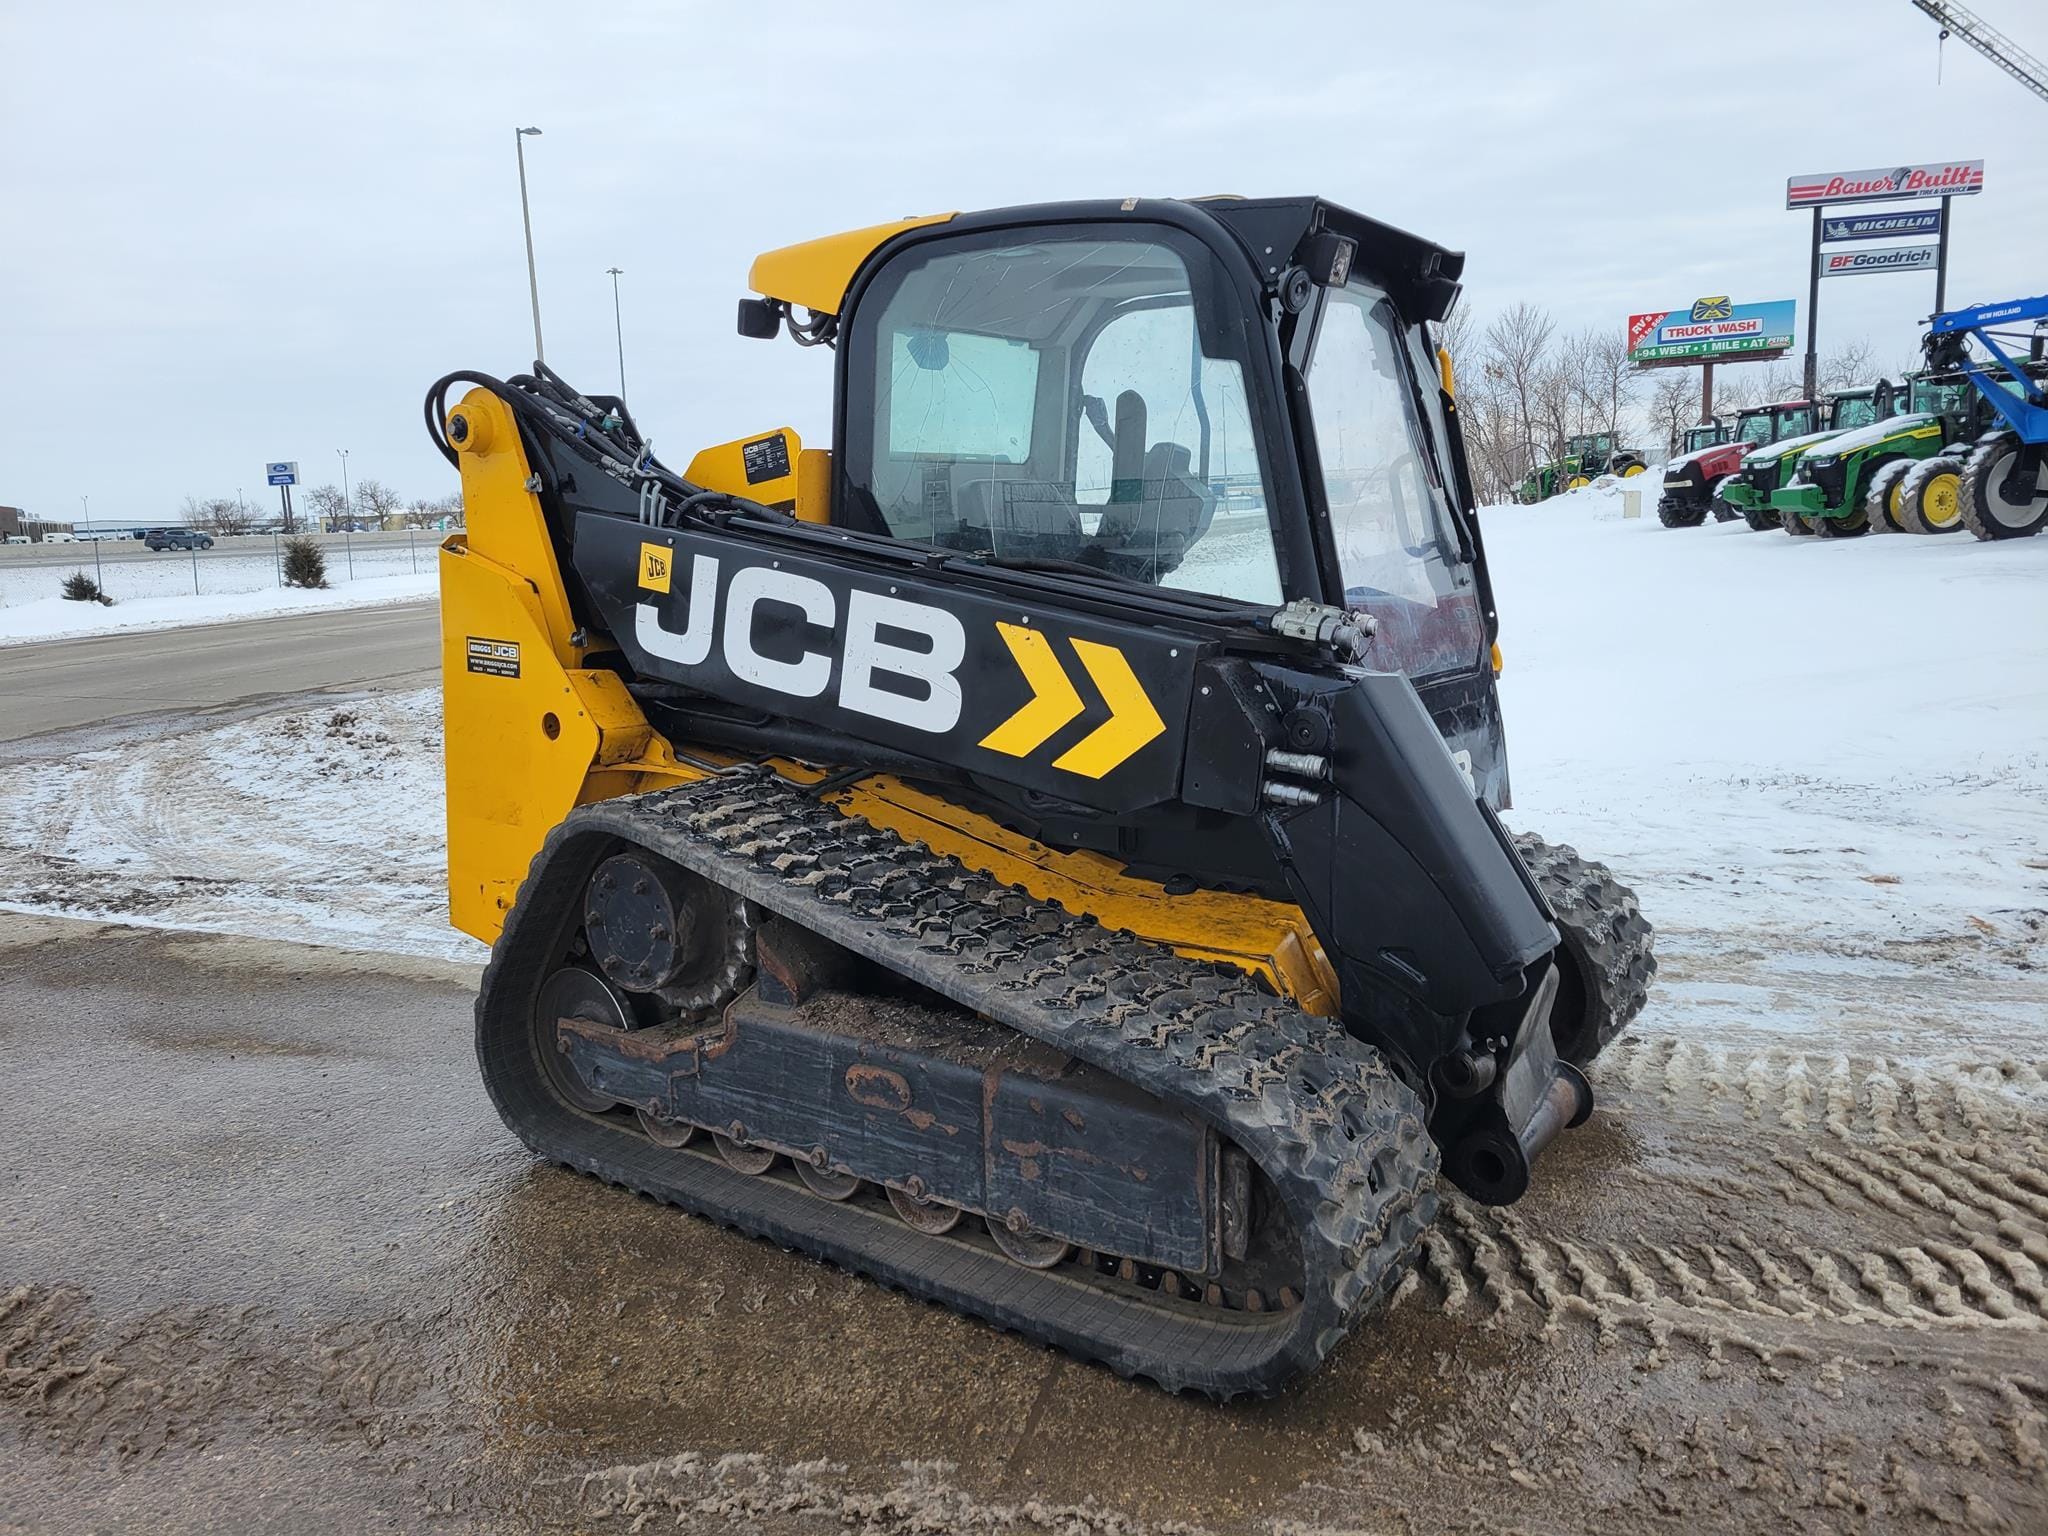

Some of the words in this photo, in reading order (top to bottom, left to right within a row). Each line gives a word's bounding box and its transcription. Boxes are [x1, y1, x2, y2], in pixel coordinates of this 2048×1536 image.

[1823, 176, 1895, 197] Bauer
[1905, 166, 1972, 190] Built
[1918, 188, 1934, 196] TIRE
[1940, 186, 1967, 195] SERVICE
[1853, 216, 1936, 232] MICHELIN
[1829, 249, 1932, 268] BFGoodrich
[1977, 312, 1993, 321] NEW
[1993, 307, 2022, 318] HOLLAND
[1632, 314, 1653, 335] RV's
[1668, 325, 1713, 338] TRUCK
[1718, 320, 1757, 333] WASH
[1659, 345, 1692, 356] WEST
[1702, 343, 1708, 352] 1
[1711, 341, 1740, 351] MILE
[1750, 338, 1765, 348] AT
[744, 445, 759, 455] JCB
[647, 553, 666, 577] JCB
[494, 646, 516, 657] JCB
[635, 553, 966, 733] JCB
